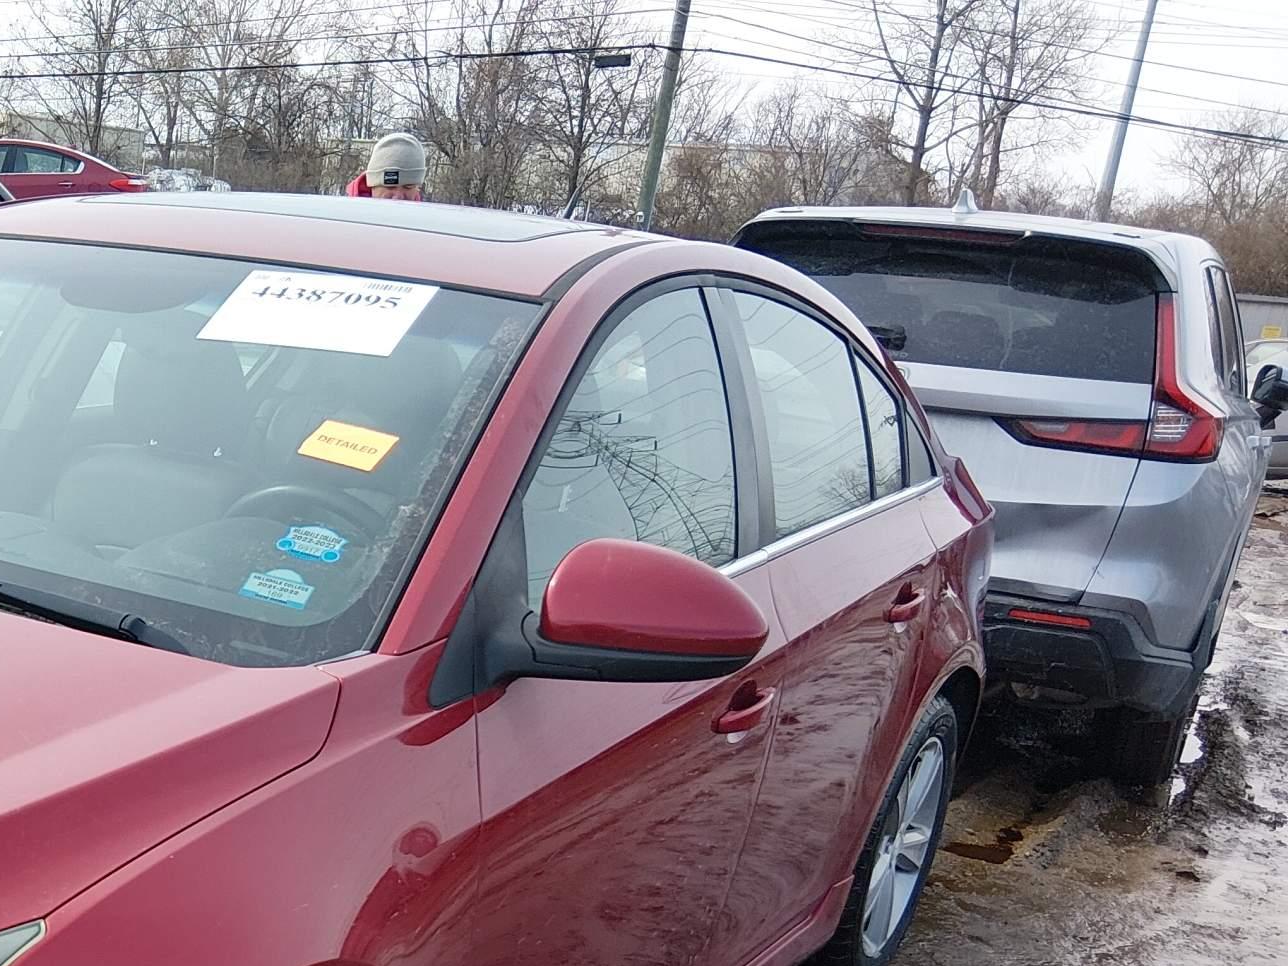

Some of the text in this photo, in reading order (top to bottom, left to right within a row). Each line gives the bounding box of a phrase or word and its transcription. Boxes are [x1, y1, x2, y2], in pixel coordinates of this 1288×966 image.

[252, 286, 402, 309] 44387095
[316, 434, 378, 455] DETAILED
[292, 534, 336, 549] 2022-2023
[319, 534, 343, 544] COLLEGE
[257, 581, 300, 595] 2021-2022
[284, 581, 309, 592] COLLEGE
